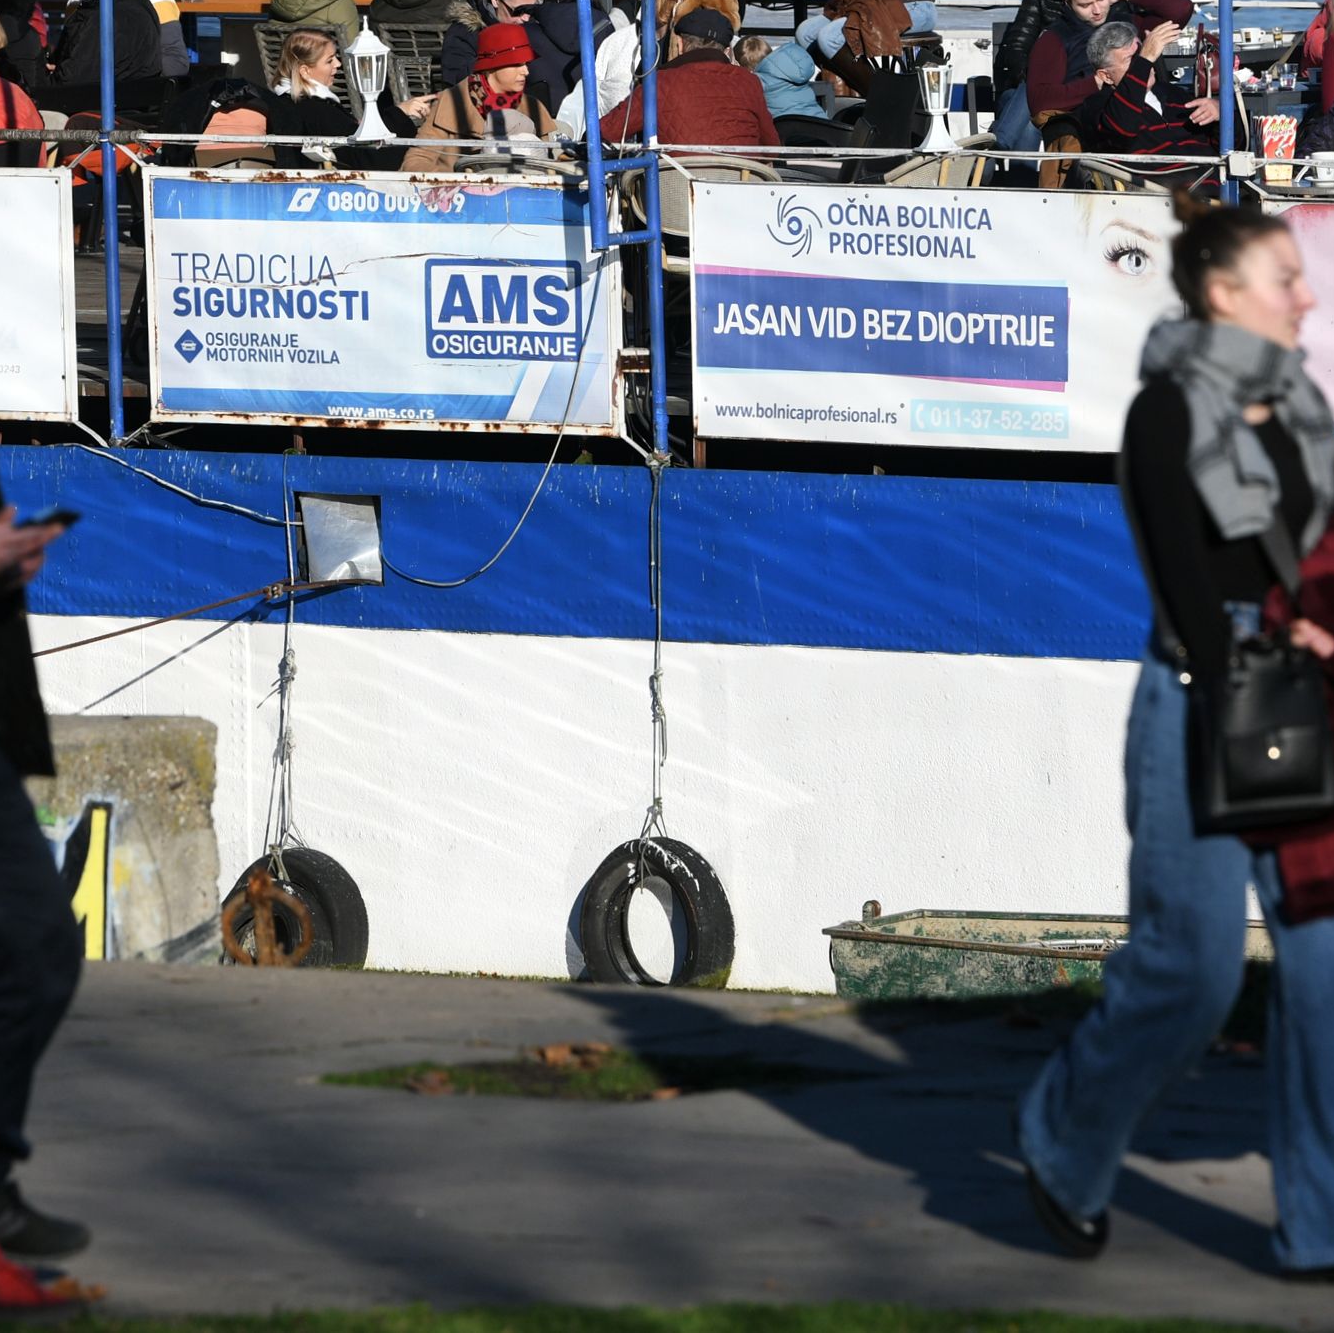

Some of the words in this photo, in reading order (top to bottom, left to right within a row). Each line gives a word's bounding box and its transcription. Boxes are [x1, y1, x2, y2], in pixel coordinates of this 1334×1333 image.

[327, 191, 380, 212] 0800
[827, 198, 890, 227] OČNA
[897, 205, 992, 230] BOLNICA
[829, 232, 976, 259] PROFESIONAL
[171, 253, 337, 286] TRADICIJA
[173, 286, 369, 321] SIGURNOSTI
[438, 274, 570, 327] AMS
[713, 303, 801, 337] JASAN
[807, 306, 857, 338] VID
[863, 309, 913, 341] BEZ
[918, 310, 1055, 347] DIOPTRIJE
[205, 332, 299, 348] OSIGURANJE
[432, 334, 577, 356] OSIGURANJE
[206, 347, 284, 363] MOTORNIH
[288, 349, 340, 364] VOZILA
[327, 406, 435, 419] www.ams.co.rs
[715, 403, 898, 424] www.bolnicaprofesional.rs
[930, 406, 1065, 432] 011-37-52-285
